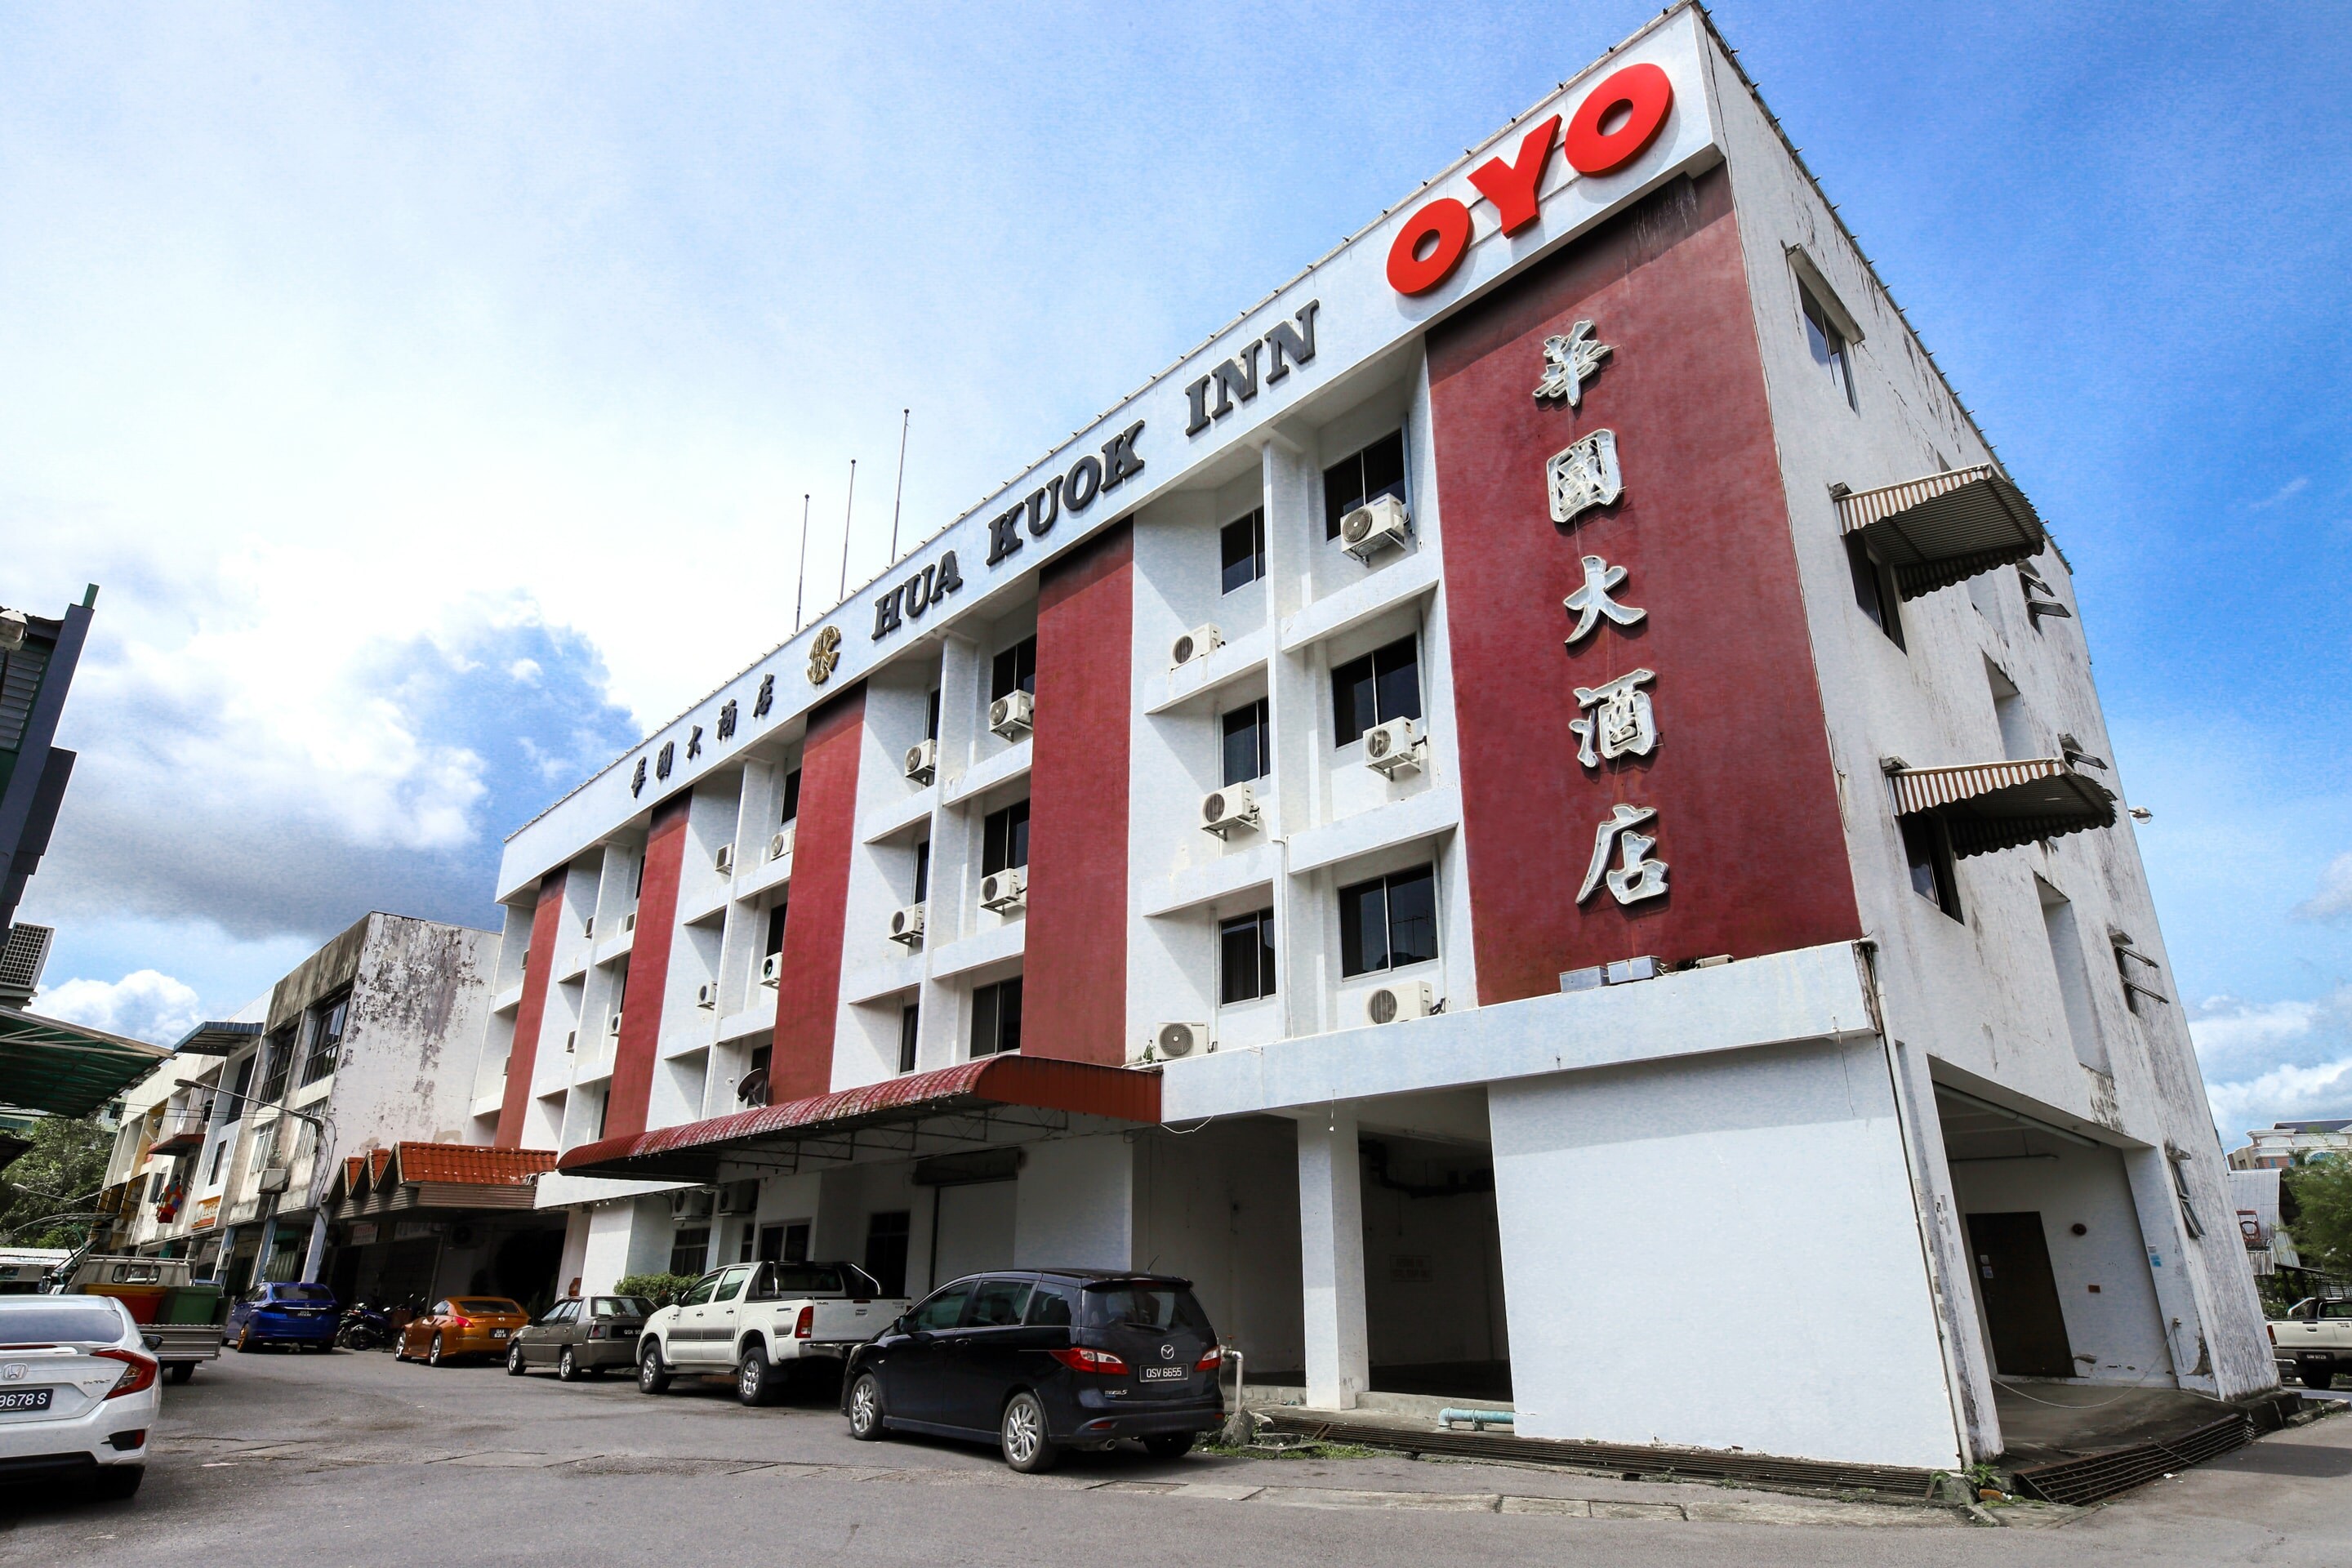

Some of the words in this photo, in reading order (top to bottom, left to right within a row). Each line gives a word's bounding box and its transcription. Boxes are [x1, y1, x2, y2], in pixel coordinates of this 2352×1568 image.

[1386, 63, 1674, 296] OYO
[871, 550, 963, 640] HUA
[987, 419, 1145, 566] KUOK
[1185, 299, 1319, 436] INN
[0, 1393, 34, 1407] 9678
[37, 1392, 47, 1405] S
[1163, 1367, 1182, 1377] 6655
